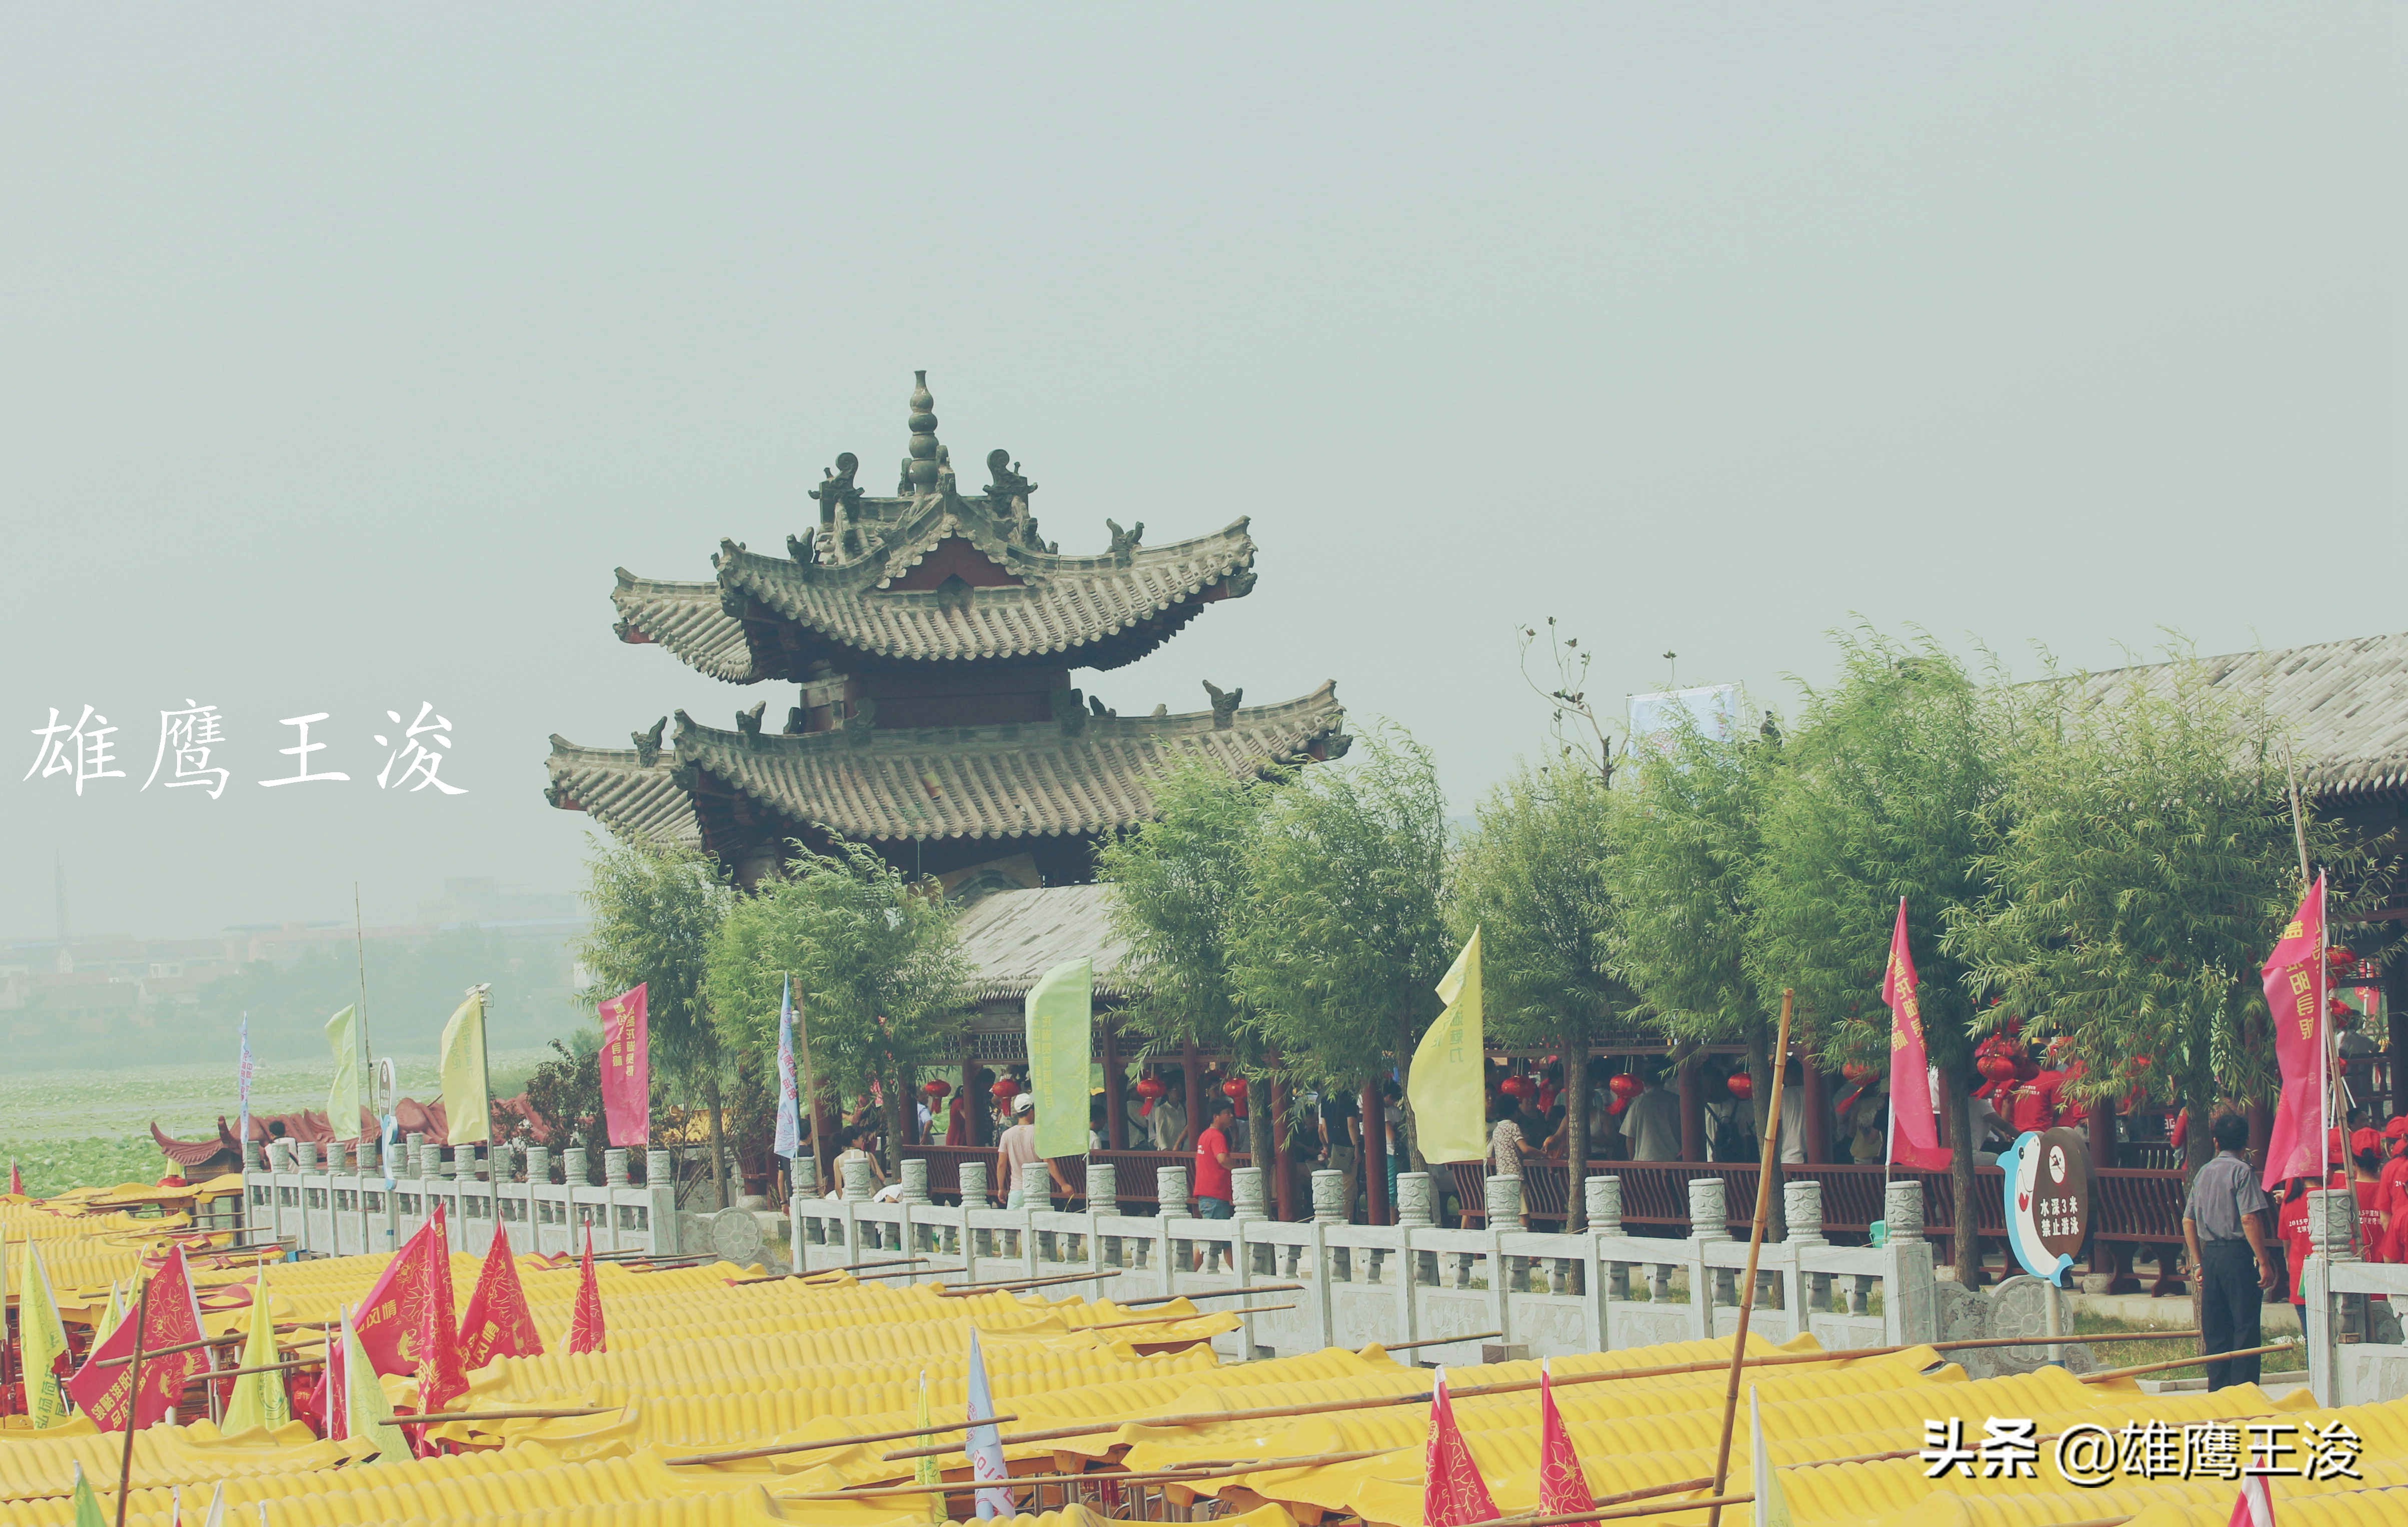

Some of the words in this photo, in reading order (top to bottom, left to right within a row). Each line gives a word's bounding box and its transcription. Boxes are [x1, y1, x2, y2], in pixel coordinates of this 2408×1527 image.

[2040, 1195, 2078, 1217] 水深3米
[2041, 1216, 2079, 1237] 禁止游泳
